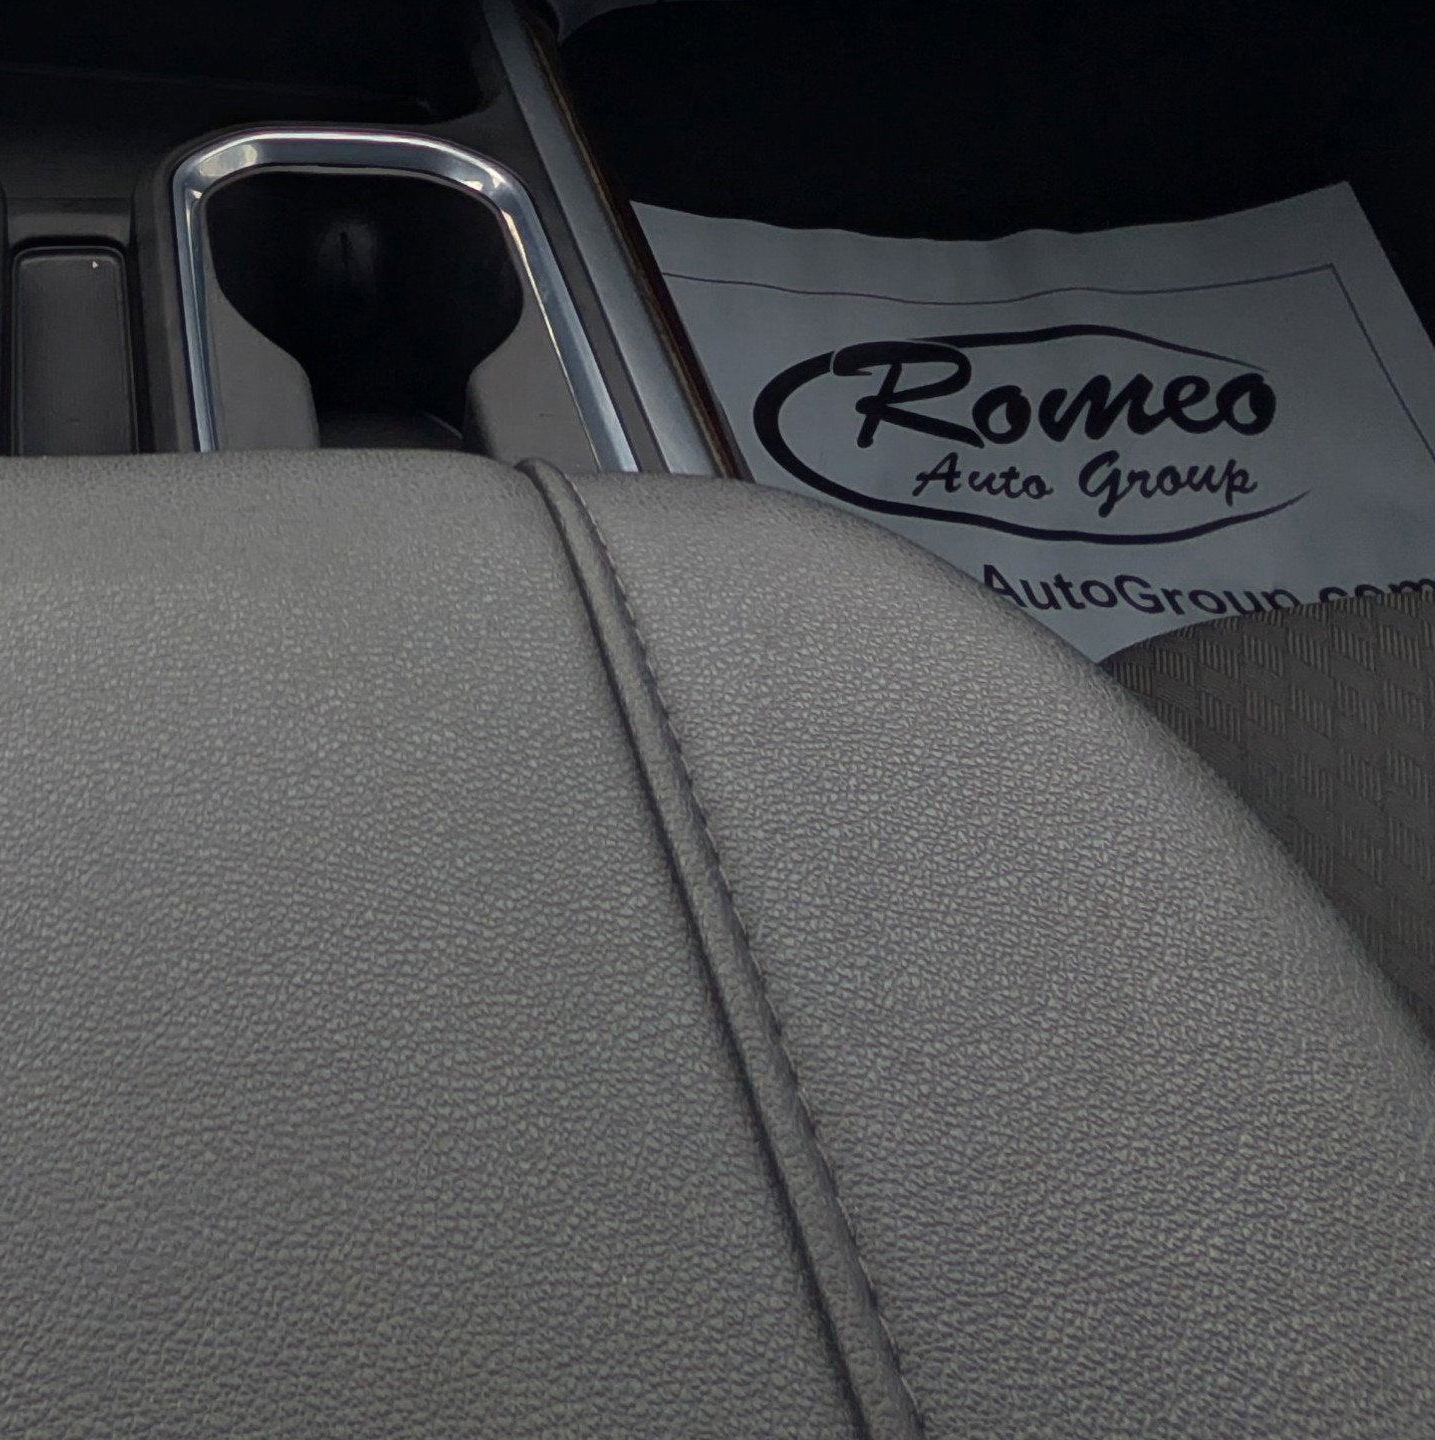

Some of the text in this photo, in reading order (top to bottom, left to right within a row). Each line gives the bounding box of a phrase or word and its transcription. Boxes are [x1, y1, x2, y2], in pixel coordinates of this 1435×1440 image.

[832, 340, 1278, 449] Romeo
[913, 449, 1260, 519] Auto Group
